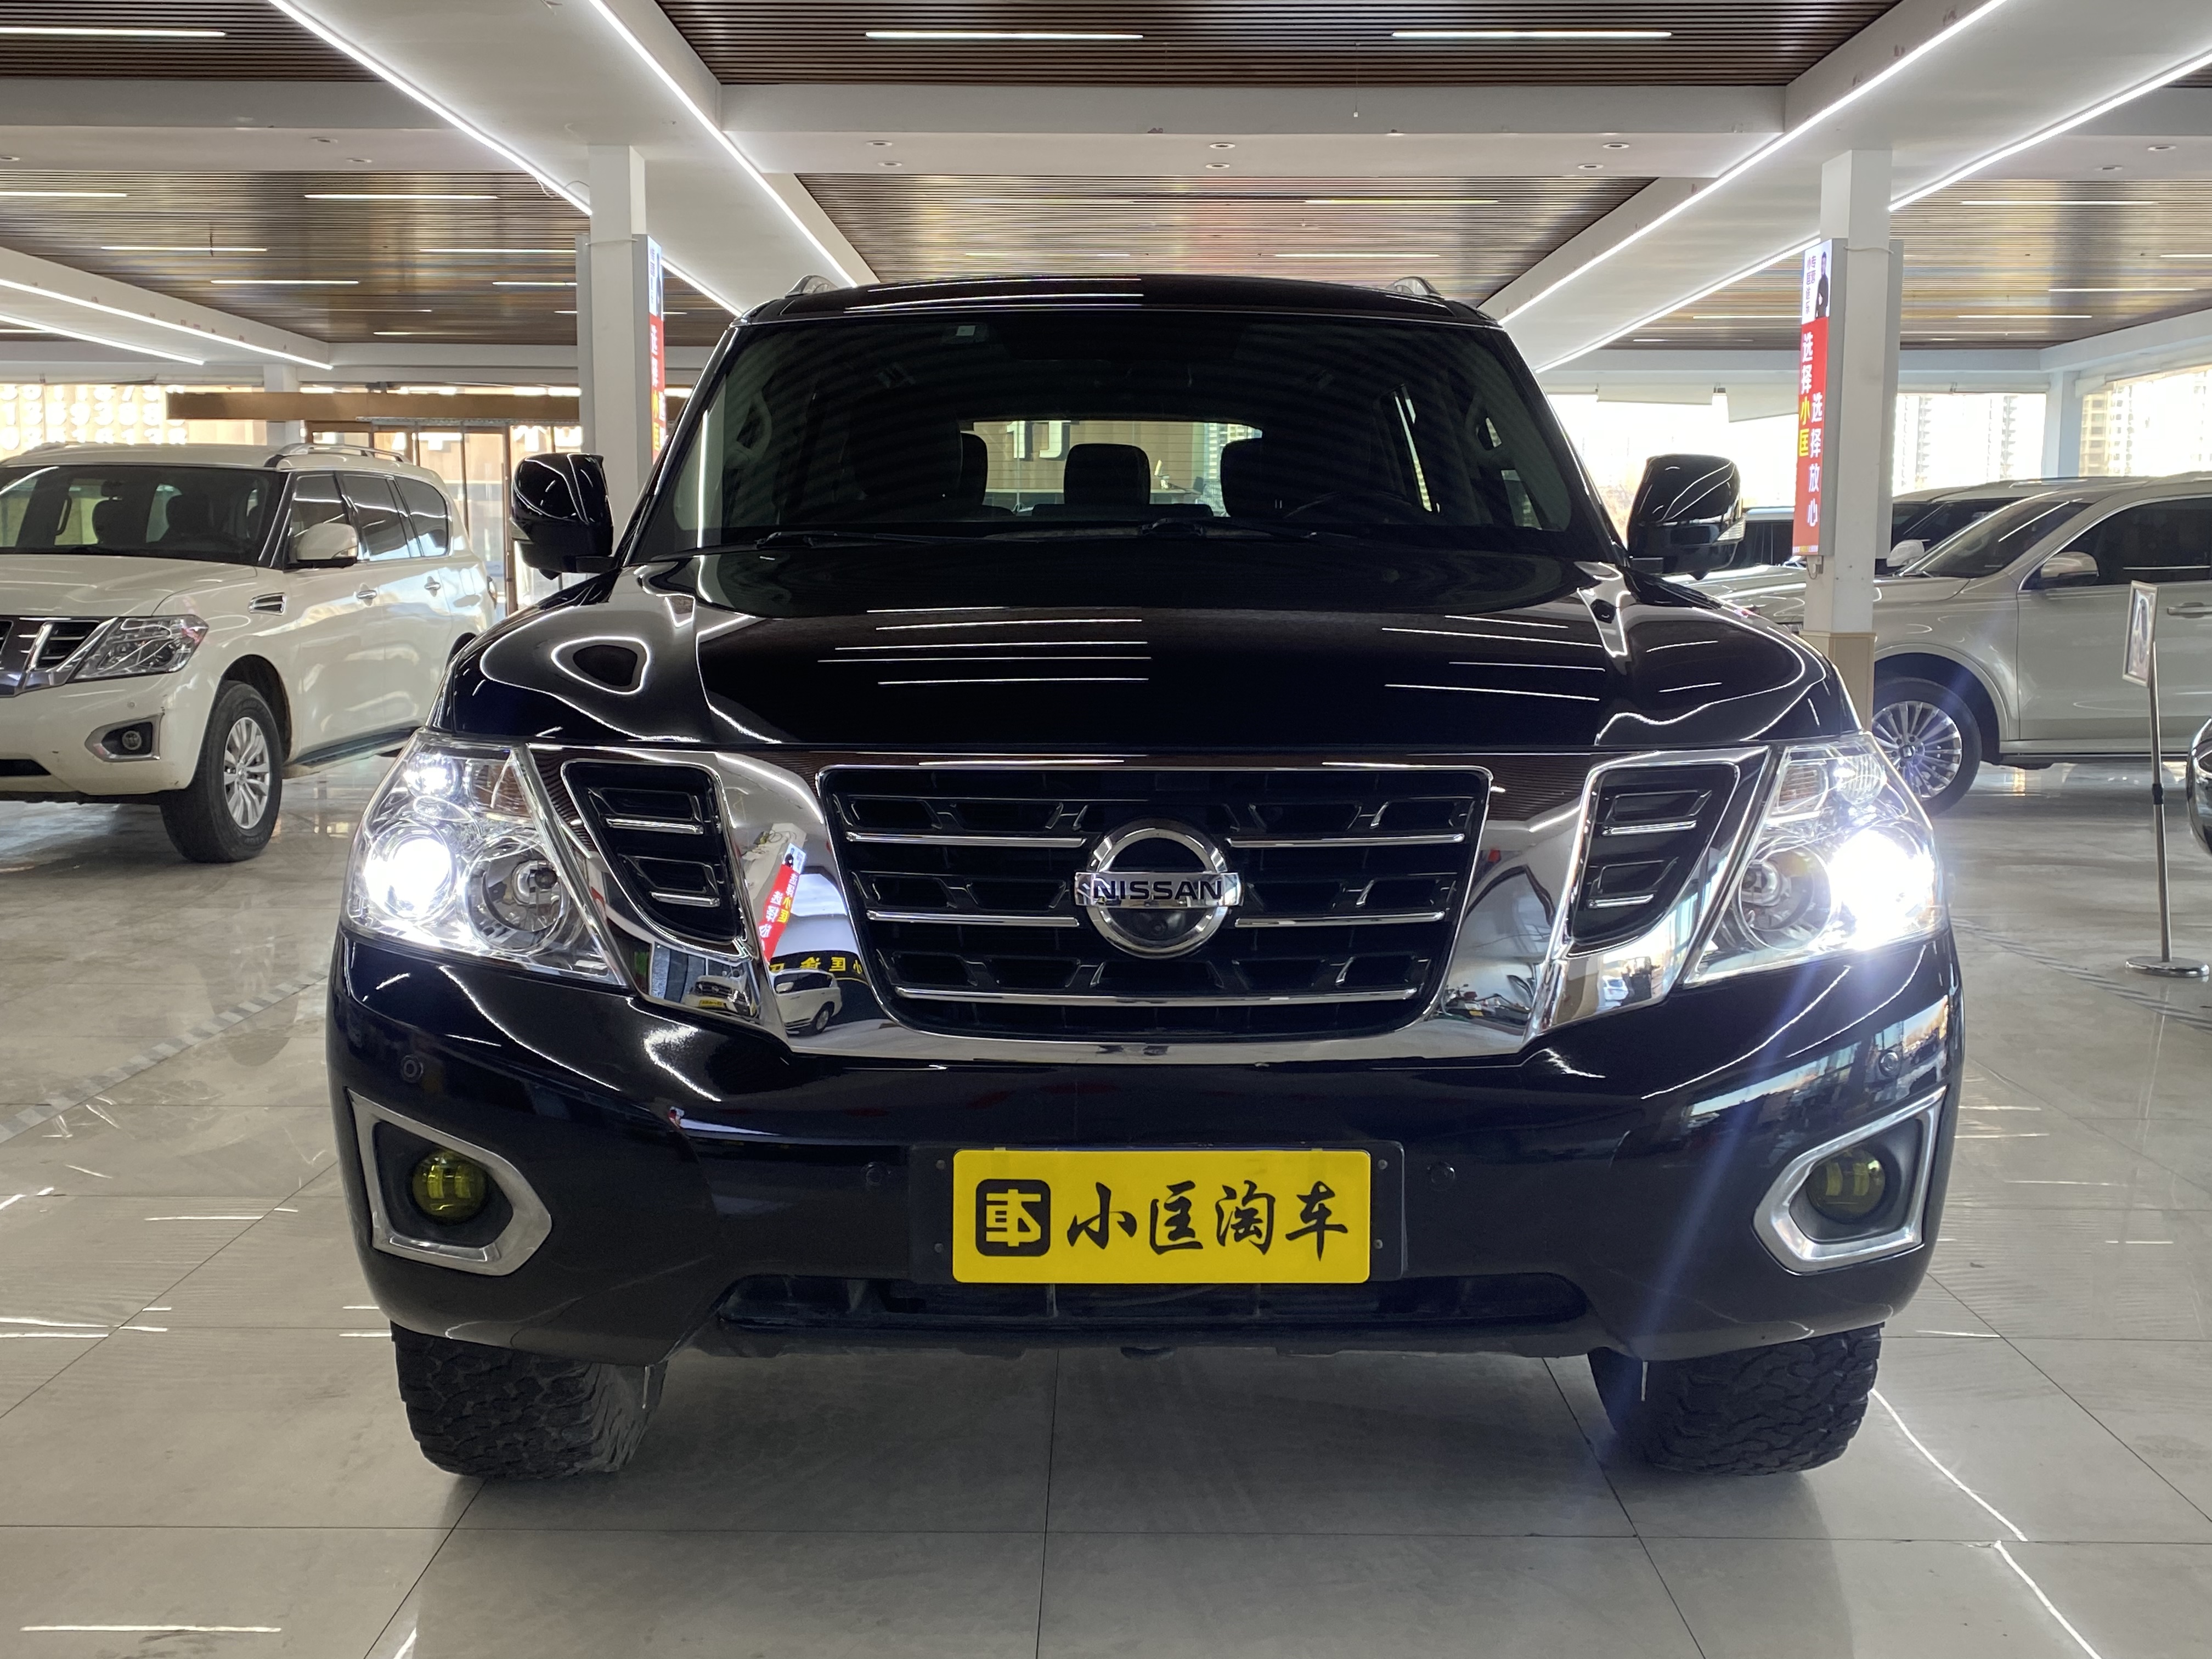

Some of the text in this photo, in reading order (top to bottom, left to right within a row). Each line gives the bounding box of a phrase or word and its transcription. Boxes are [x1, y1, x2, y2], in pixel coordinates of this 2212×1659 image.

[1799, 331, 1814, 457] 选择小匡
[1807, 392, 1823, 527] 选择放心
[1093, 880, 1222, 900] NISSAN
[1066, 1180, 1348, 1261] 小匡淘车
